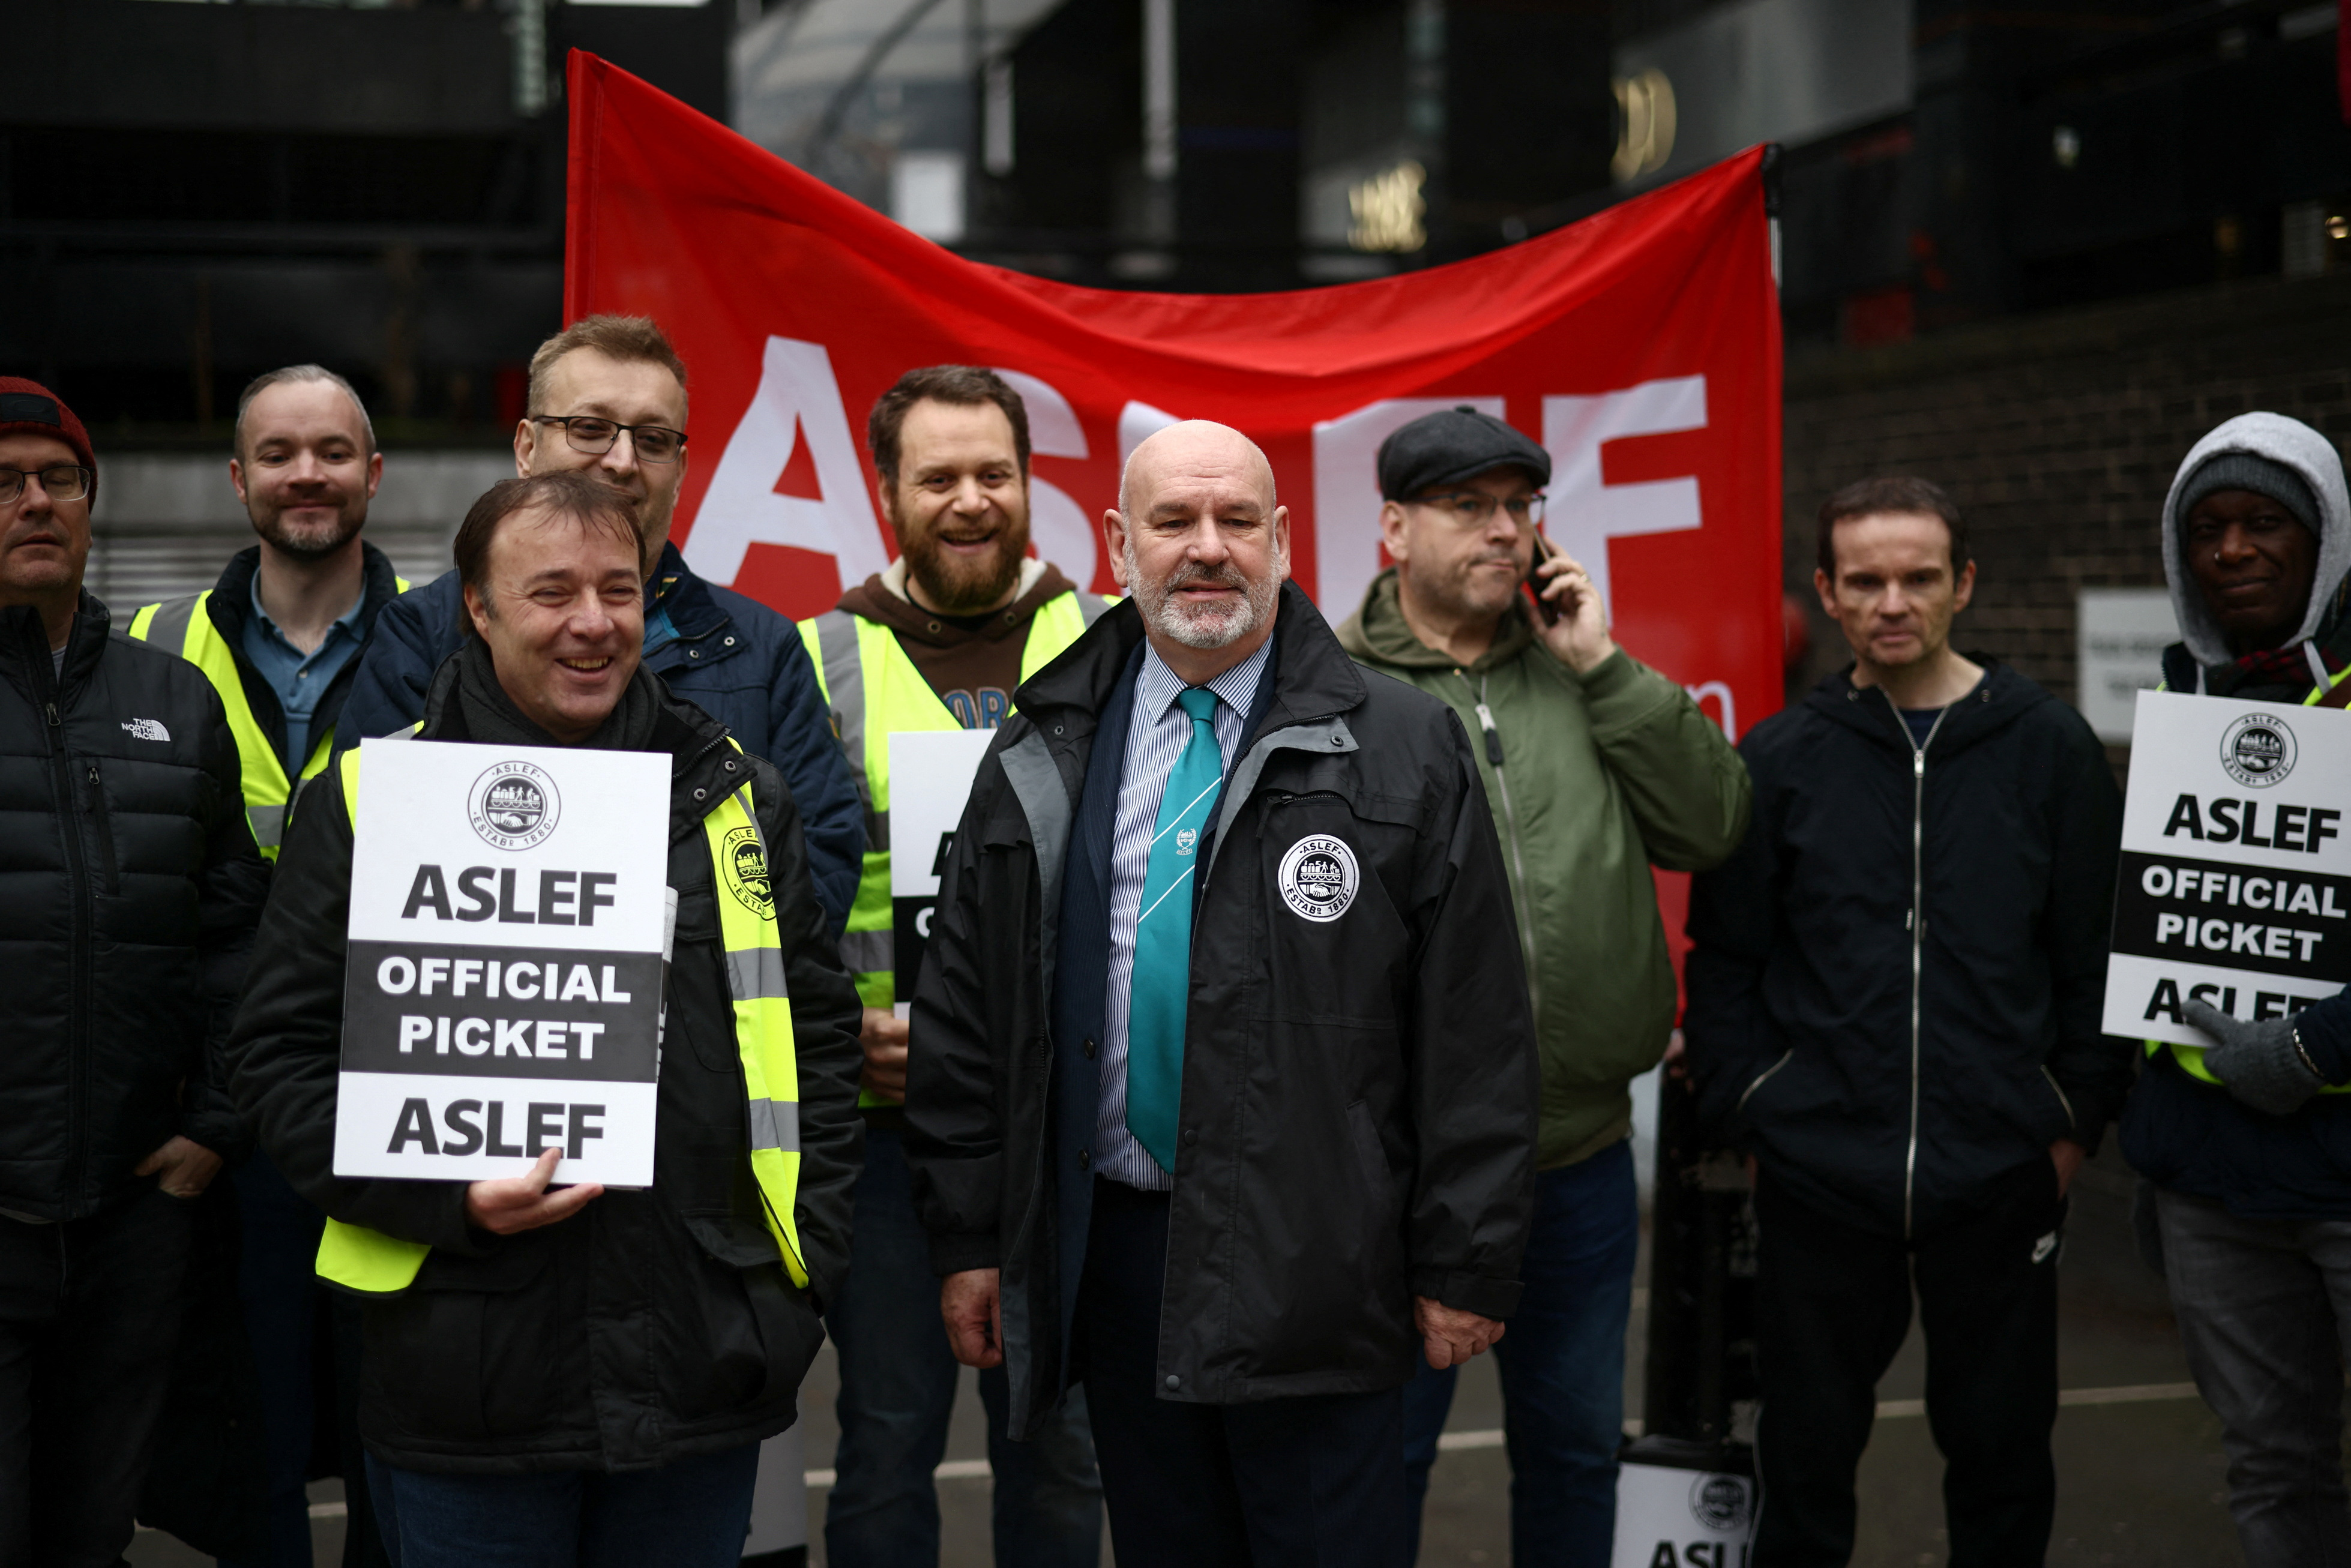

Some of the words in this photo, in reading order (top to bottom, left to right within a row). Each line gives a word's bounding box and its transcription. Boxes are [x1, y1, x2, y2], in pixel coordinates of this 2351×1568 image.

[121, 722, 153, 733] NORTH
[133, 731, 155, 740] FACE
[496, 764, 538, 775] ASLEF
[524, 823, 551, 844] 1880
[729, 829, 757, 844] ASLE
[2163, 793, 2341, 853] ASLEF
[1303, 842, 1339, 853] ASLEF
[401, 864, 617, 926] ASLEF
[1328, 893, 1348, 912] 1880
[2142, 865, 2347, 919] OFFICIAL
[2156, 912, 2323, 962] PICKET
[378, 957, 631, 1003] OFFICIAL
[399, 1015, 605, 1059] PICKET
[387, 1098, 606, 1159] ASLEF
